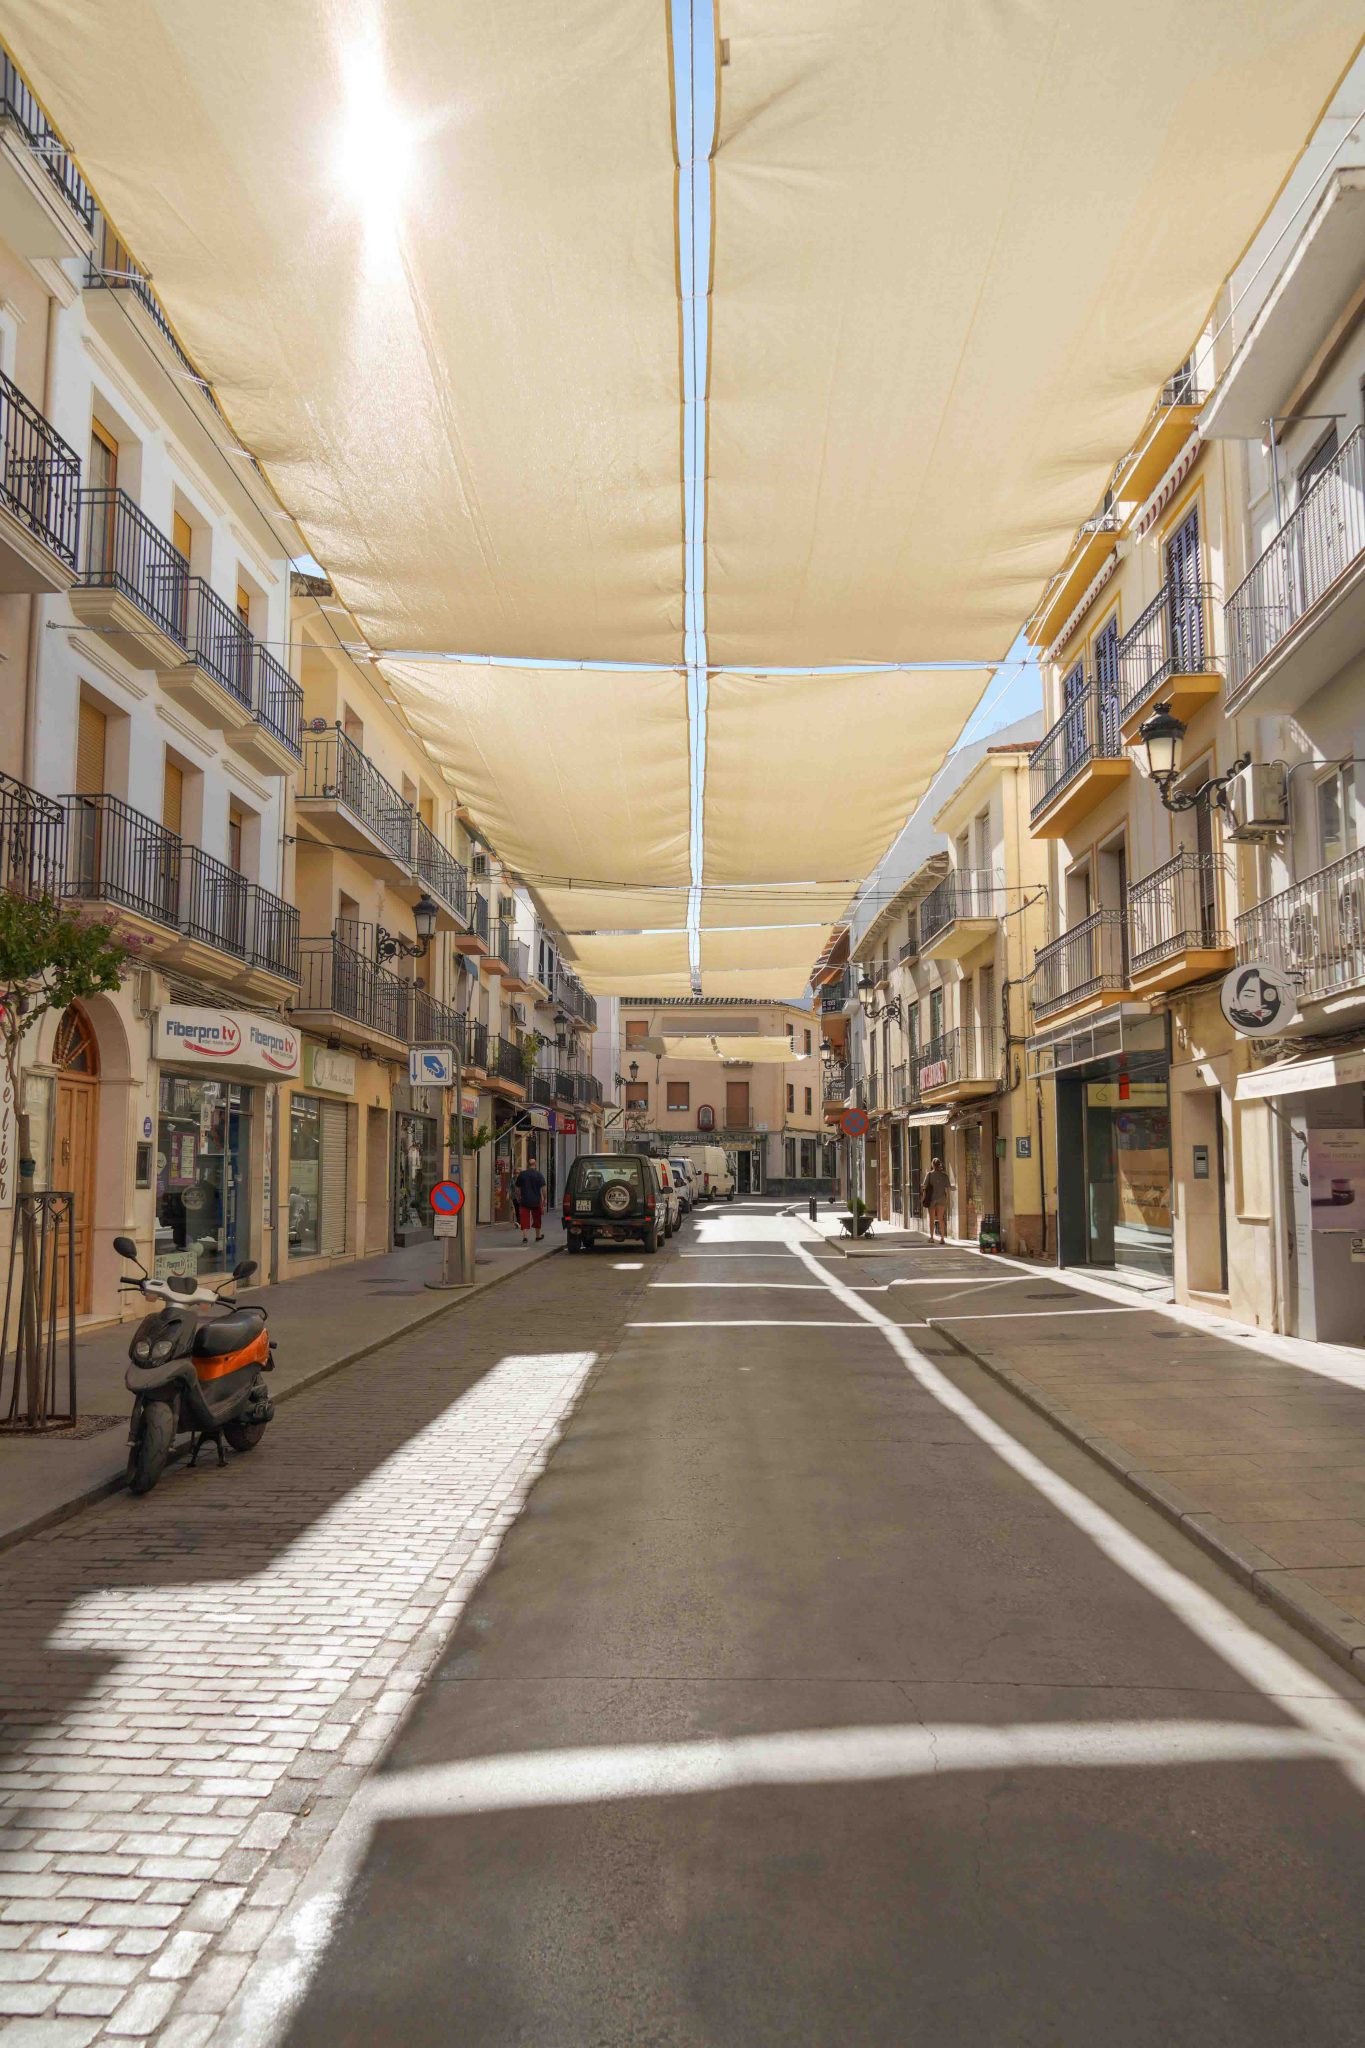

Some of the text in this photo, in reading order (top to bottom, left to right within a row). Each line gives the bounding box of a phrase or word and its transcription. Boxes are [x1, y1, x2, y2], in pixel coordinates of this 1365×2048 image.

[166, 1021, 236, 1044] Fiberpro tv
[250, 1026, 294, 1053] Fiberpro tv
